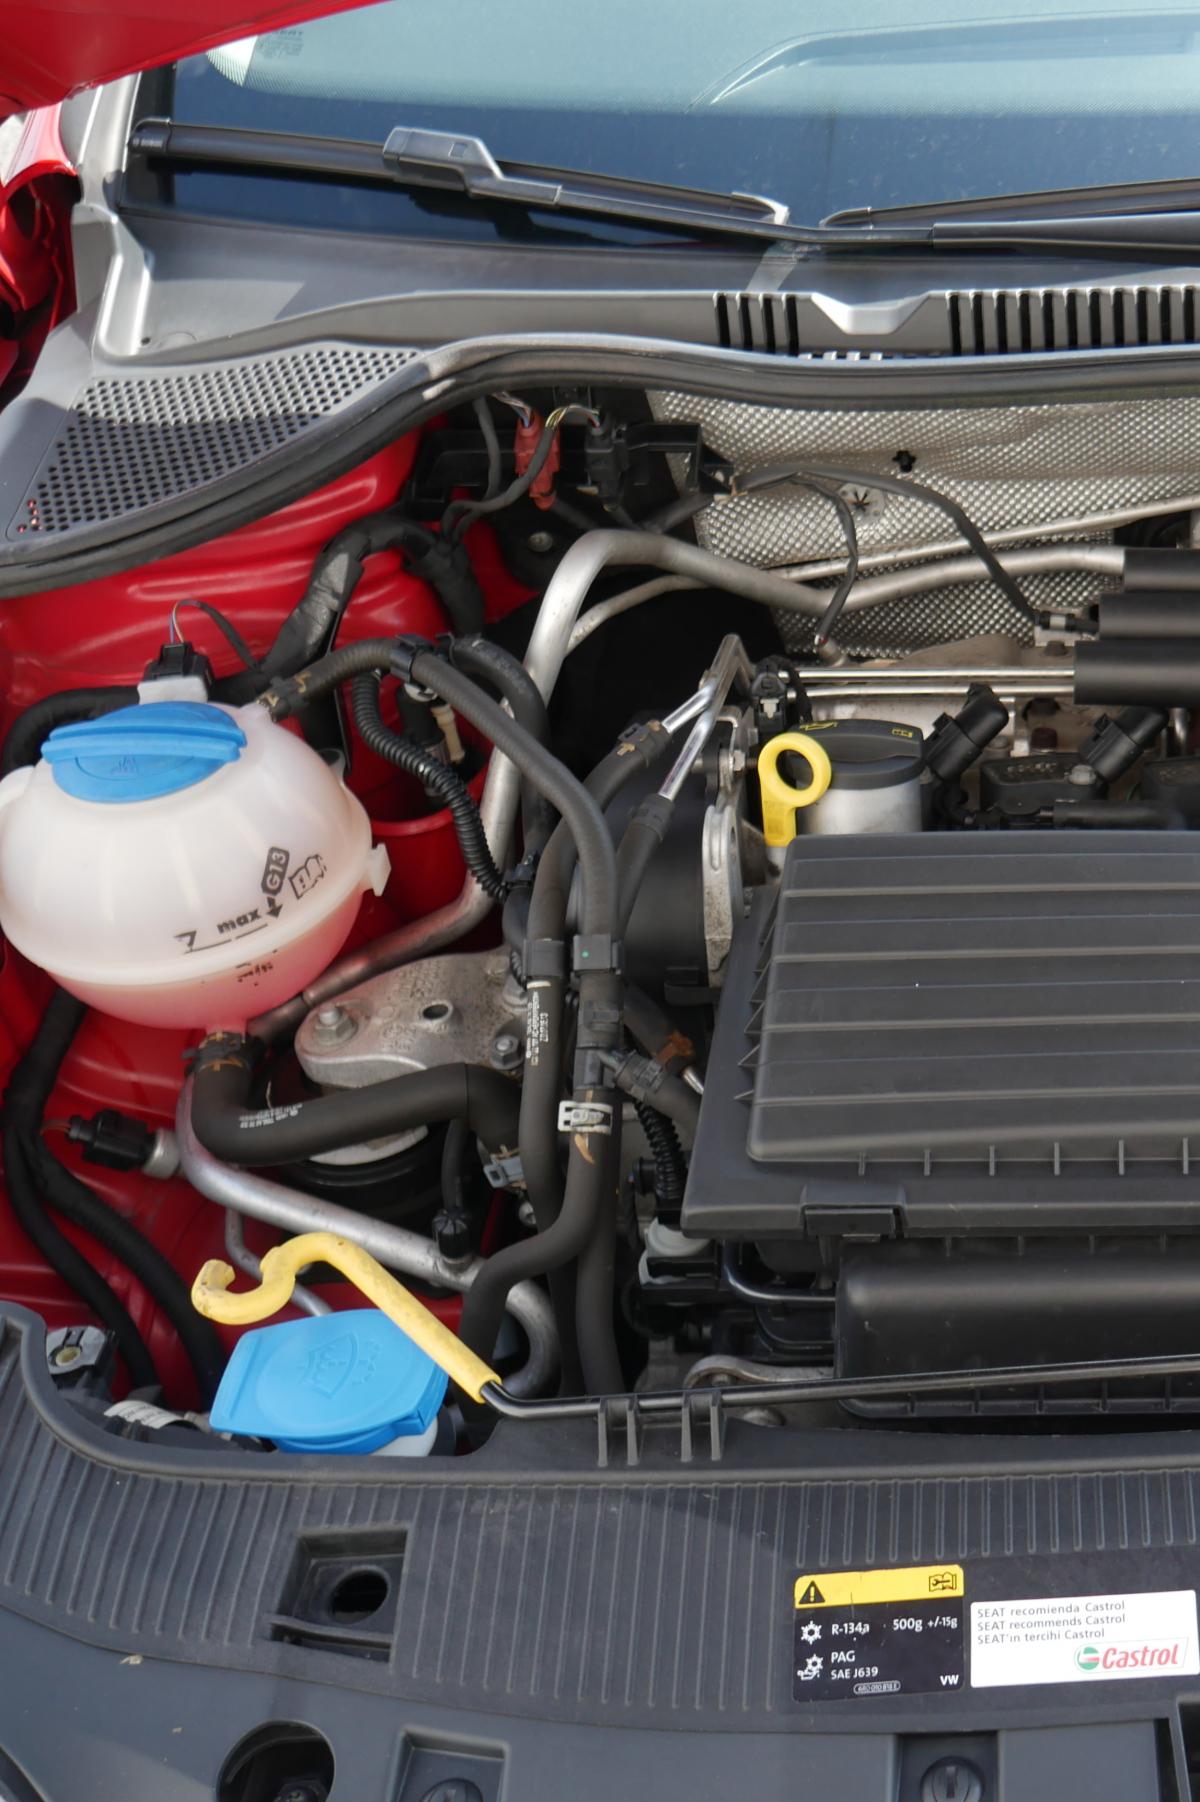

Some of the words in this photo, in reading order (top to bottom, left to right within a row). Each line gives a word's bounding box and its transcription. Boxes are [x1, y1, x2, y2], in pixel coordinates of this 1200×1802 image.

[266, 851, 287, 891] G13
[216, 908, 262, 934] max
[977, 1607, 1006, 1619] SEAT
[1010, 1604, 1080, 1616] recomienda
[1085, 1600, 1126, 1612] Castrol
[831, 1621, 870, 1636] R-134a
[893, 1617, 923, 1633] 500g
[927, 1616, 958, 1630] +/-15g
[977, 1620, 1006, 1632] SEAT
[1009, 1616, 1082, 1630] recommends
[1085, 1613, 1126, 1625] Castrol
[1025, 1630, 1062, 1642] tercihi
[1064, 1627, 1105, 1640] Castrol
[830, 1650, 856, 1664] PAG
[1102, 1643, 1180, 1670] Castrol
[830, 1668, 850, 1681] SAE
[853, 1666, 879, 1679] J639
[940, 1674, 960, 1687] VW
